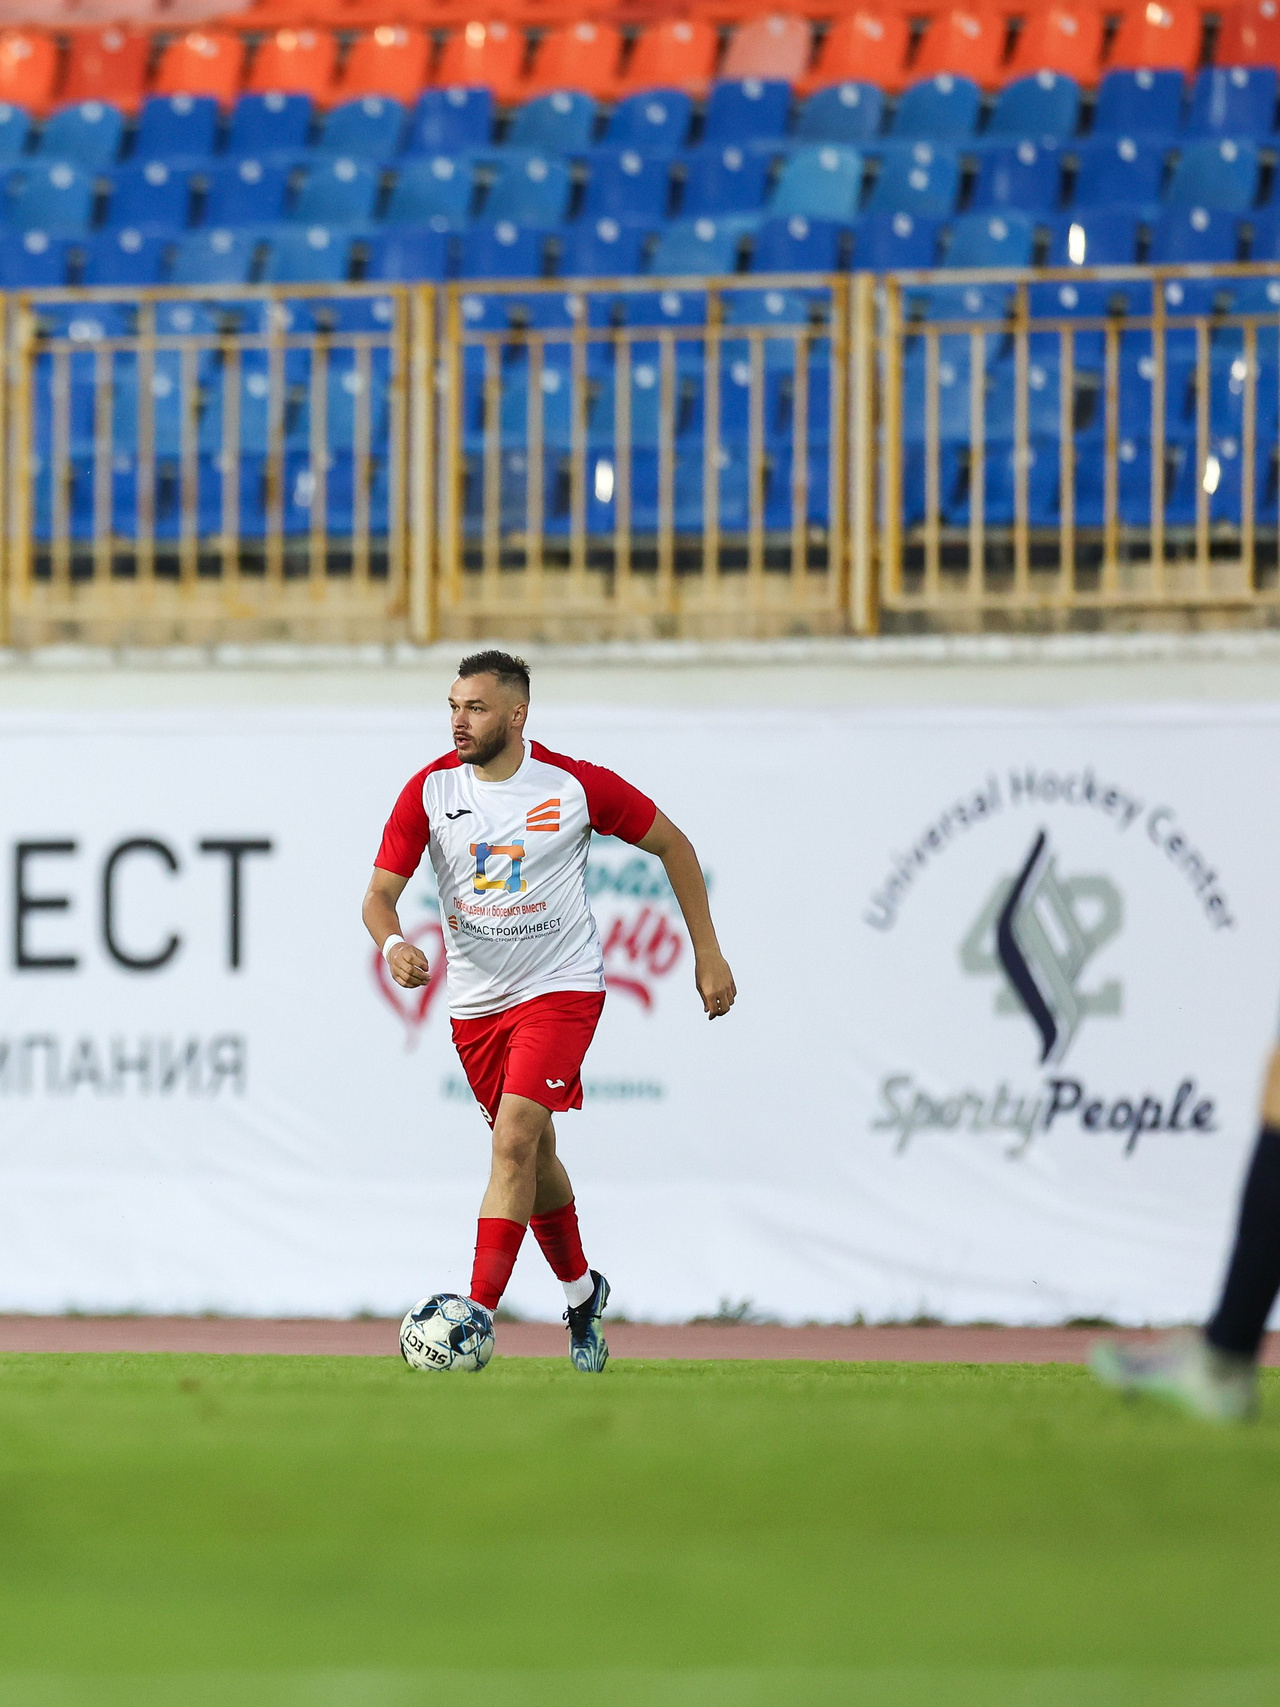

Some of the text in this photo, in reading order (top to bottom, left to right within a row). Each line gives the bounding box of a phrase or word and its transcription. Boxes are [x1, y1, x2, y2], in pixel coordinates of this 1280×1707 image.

[864, 766, 1236, 932] Universal Hockey Center
[521, 902, 547, 914] вместе
[405, 1330, 448, 1365] SELECT
